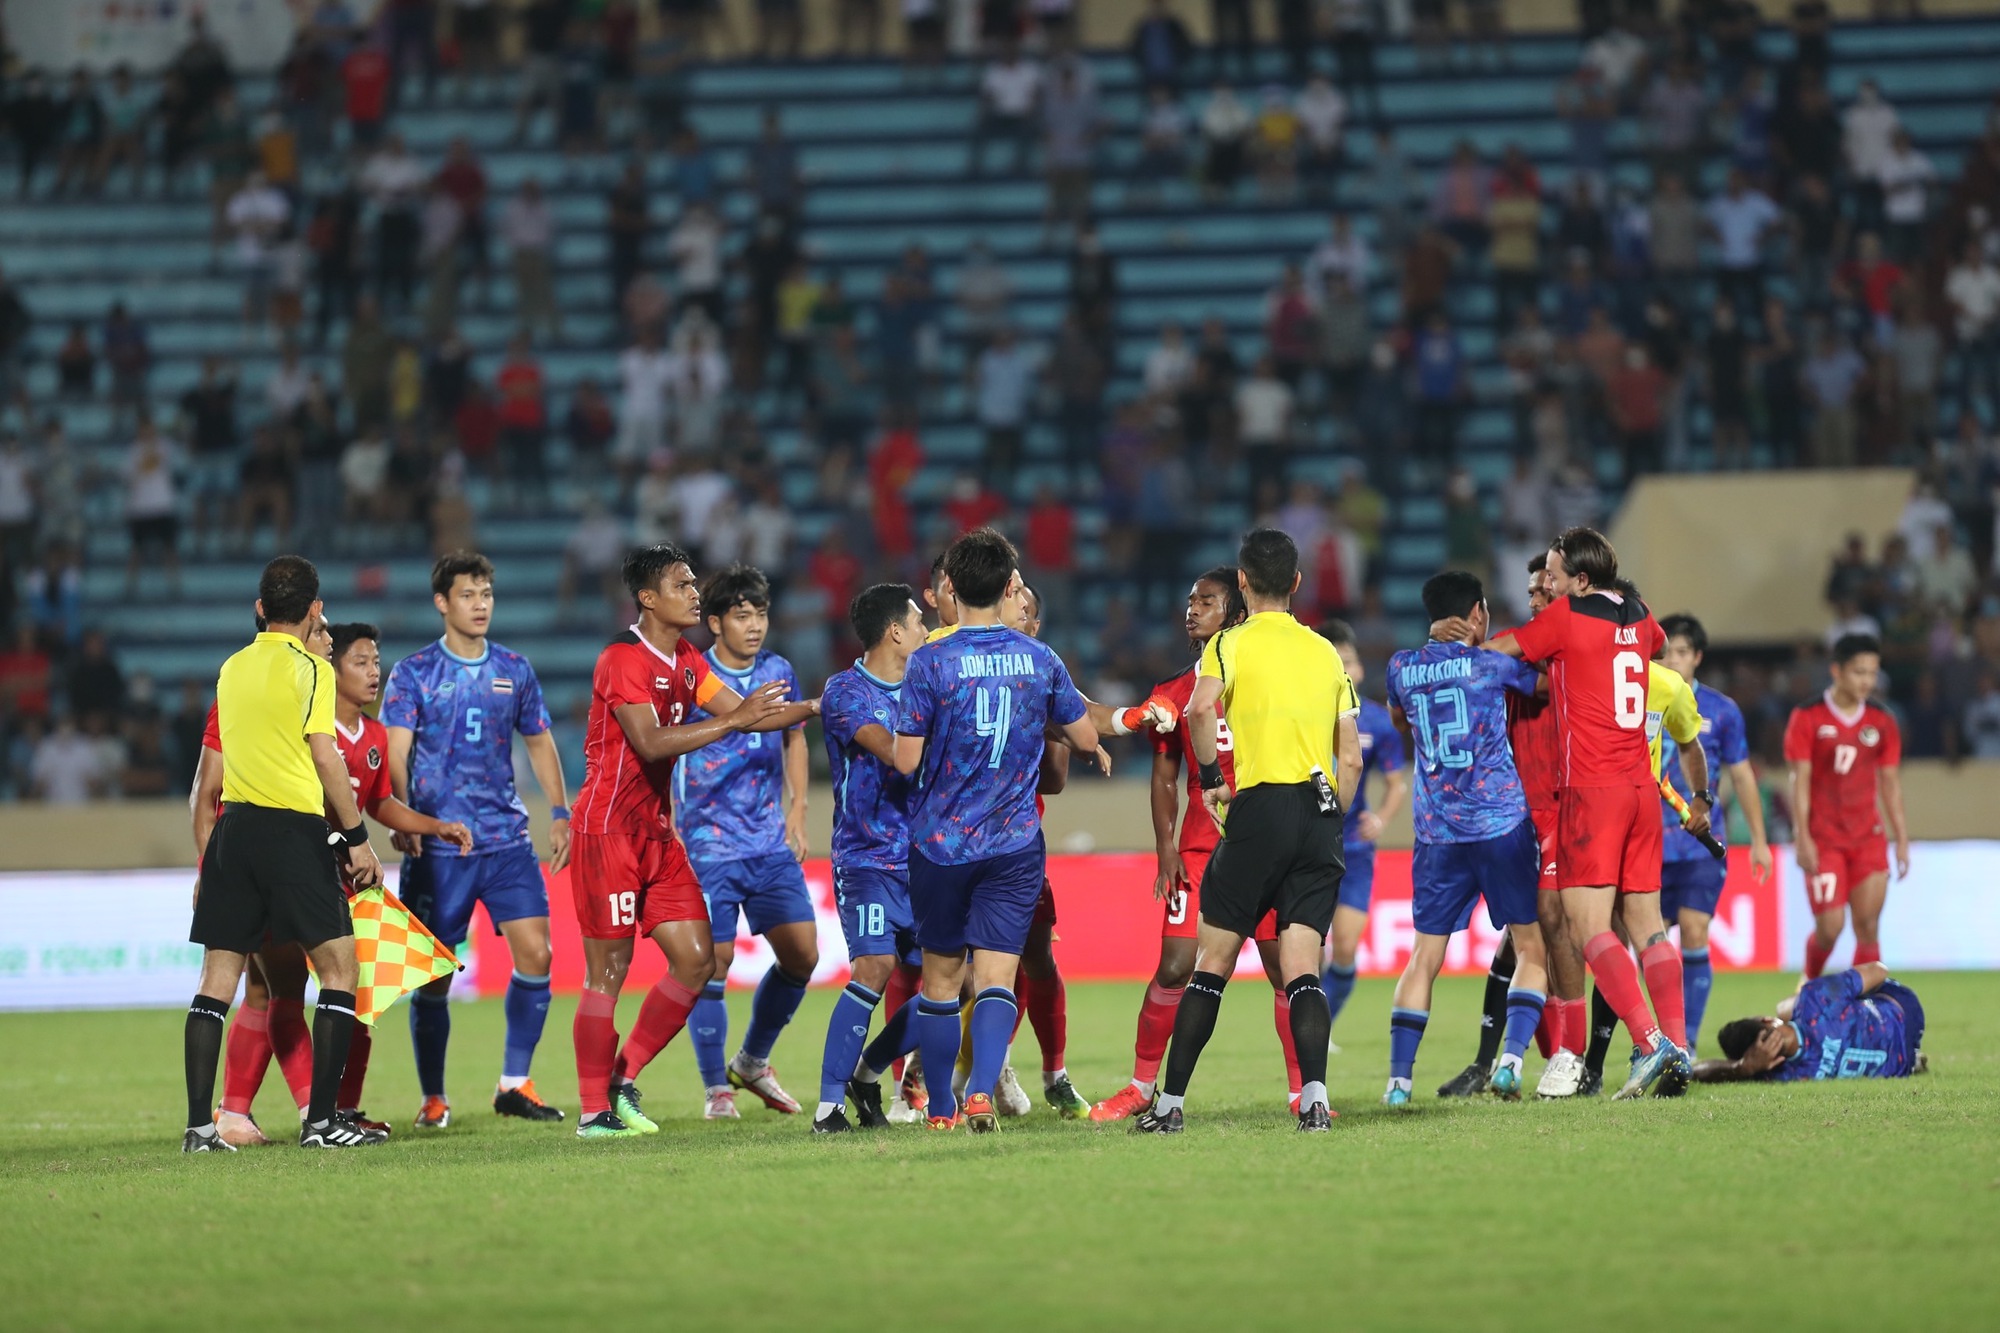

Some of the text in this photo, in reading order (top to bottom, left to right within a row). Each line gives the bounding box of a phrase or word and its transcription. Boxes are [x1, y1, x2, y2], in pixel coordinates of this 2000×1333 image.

[1615, 627, 1638, 645] KLOK
[958, 654, 1034, 678] JONATHAN
[1402, 657, 1471, 688] NARAKORN
[1613, 651, 1644, 728] 6
[465, 708, 481, 742] 5
[976, 686, 1011, 769] 4
[1411, 687, 1473, 768] 12
[1834, 744, 1857, 775] 17
[1812, 872, 1837, 903] 17
[609, 891, 635, 926] 19
[856, 903, 884, 937] 18
[190, 1007, 221, 1019] KELME
